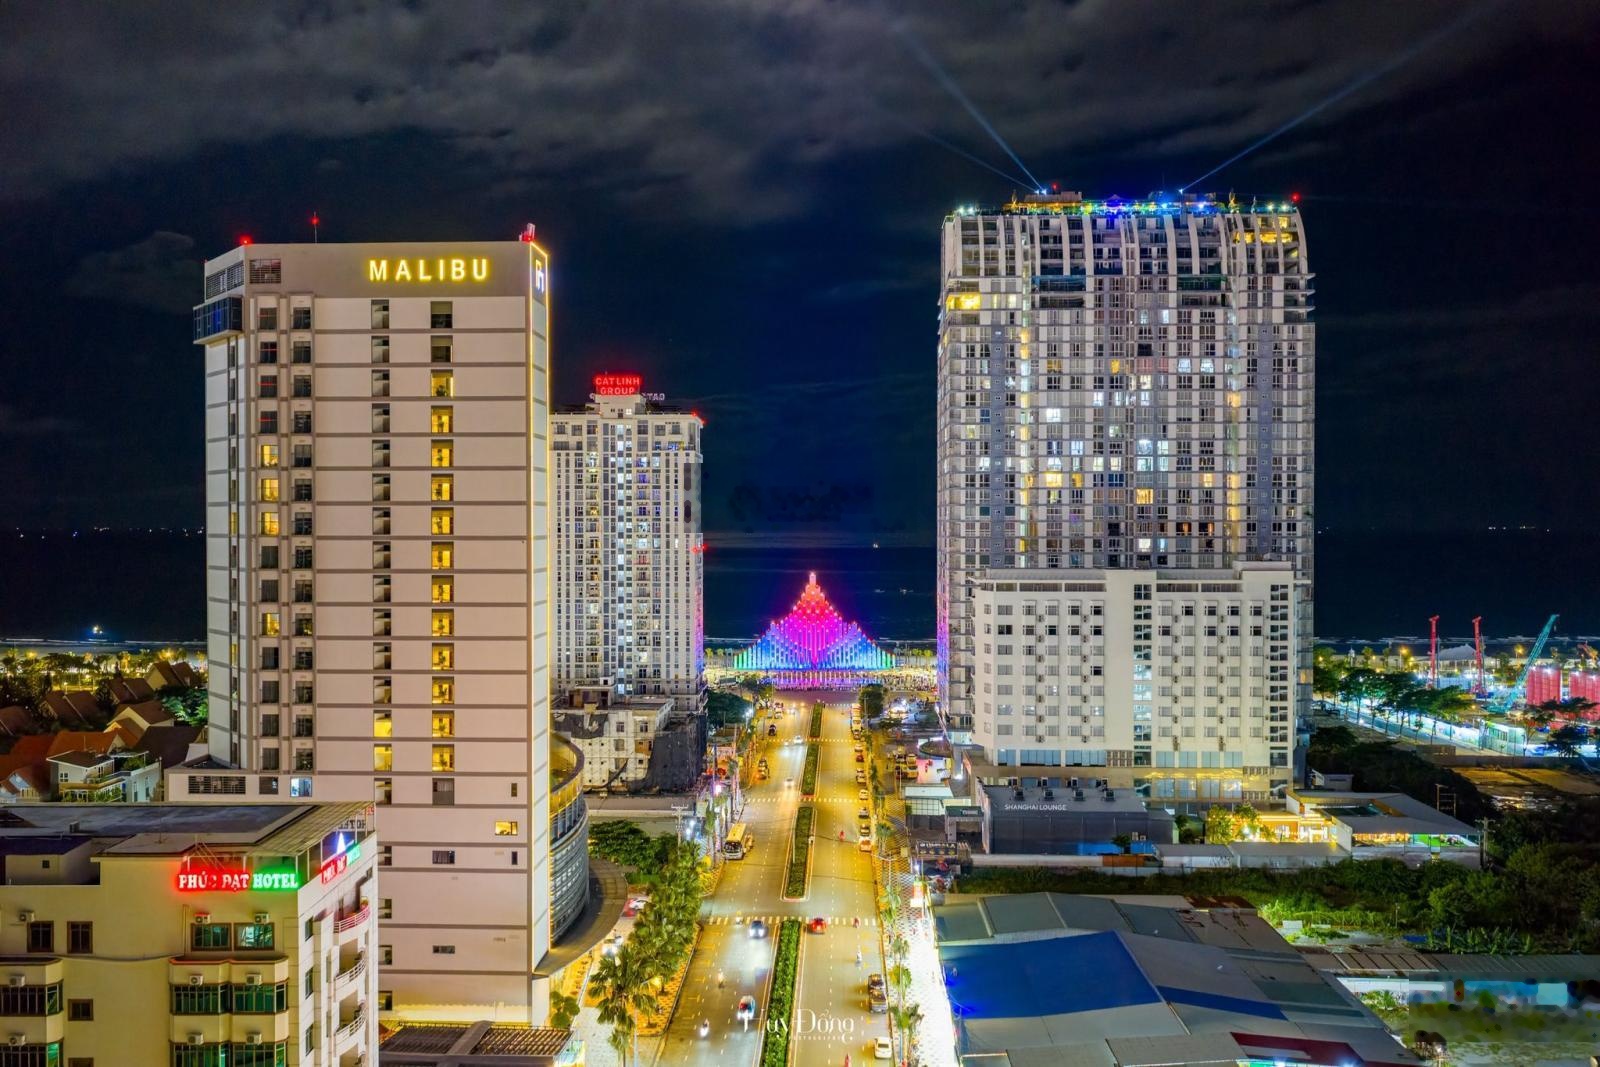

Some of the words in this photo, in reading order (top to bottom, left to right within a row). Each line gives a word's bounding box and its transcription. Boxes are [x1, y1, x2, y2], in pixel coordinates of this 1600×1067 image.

[369, 258, 488, 281] MALIBU
[616, 377, 640, 386] LINH
[600, 386, 635, 395] GROUP
[1040, 803, 1068, 811] LOUNGE
[252, 873, 299, 889] HOTEL
